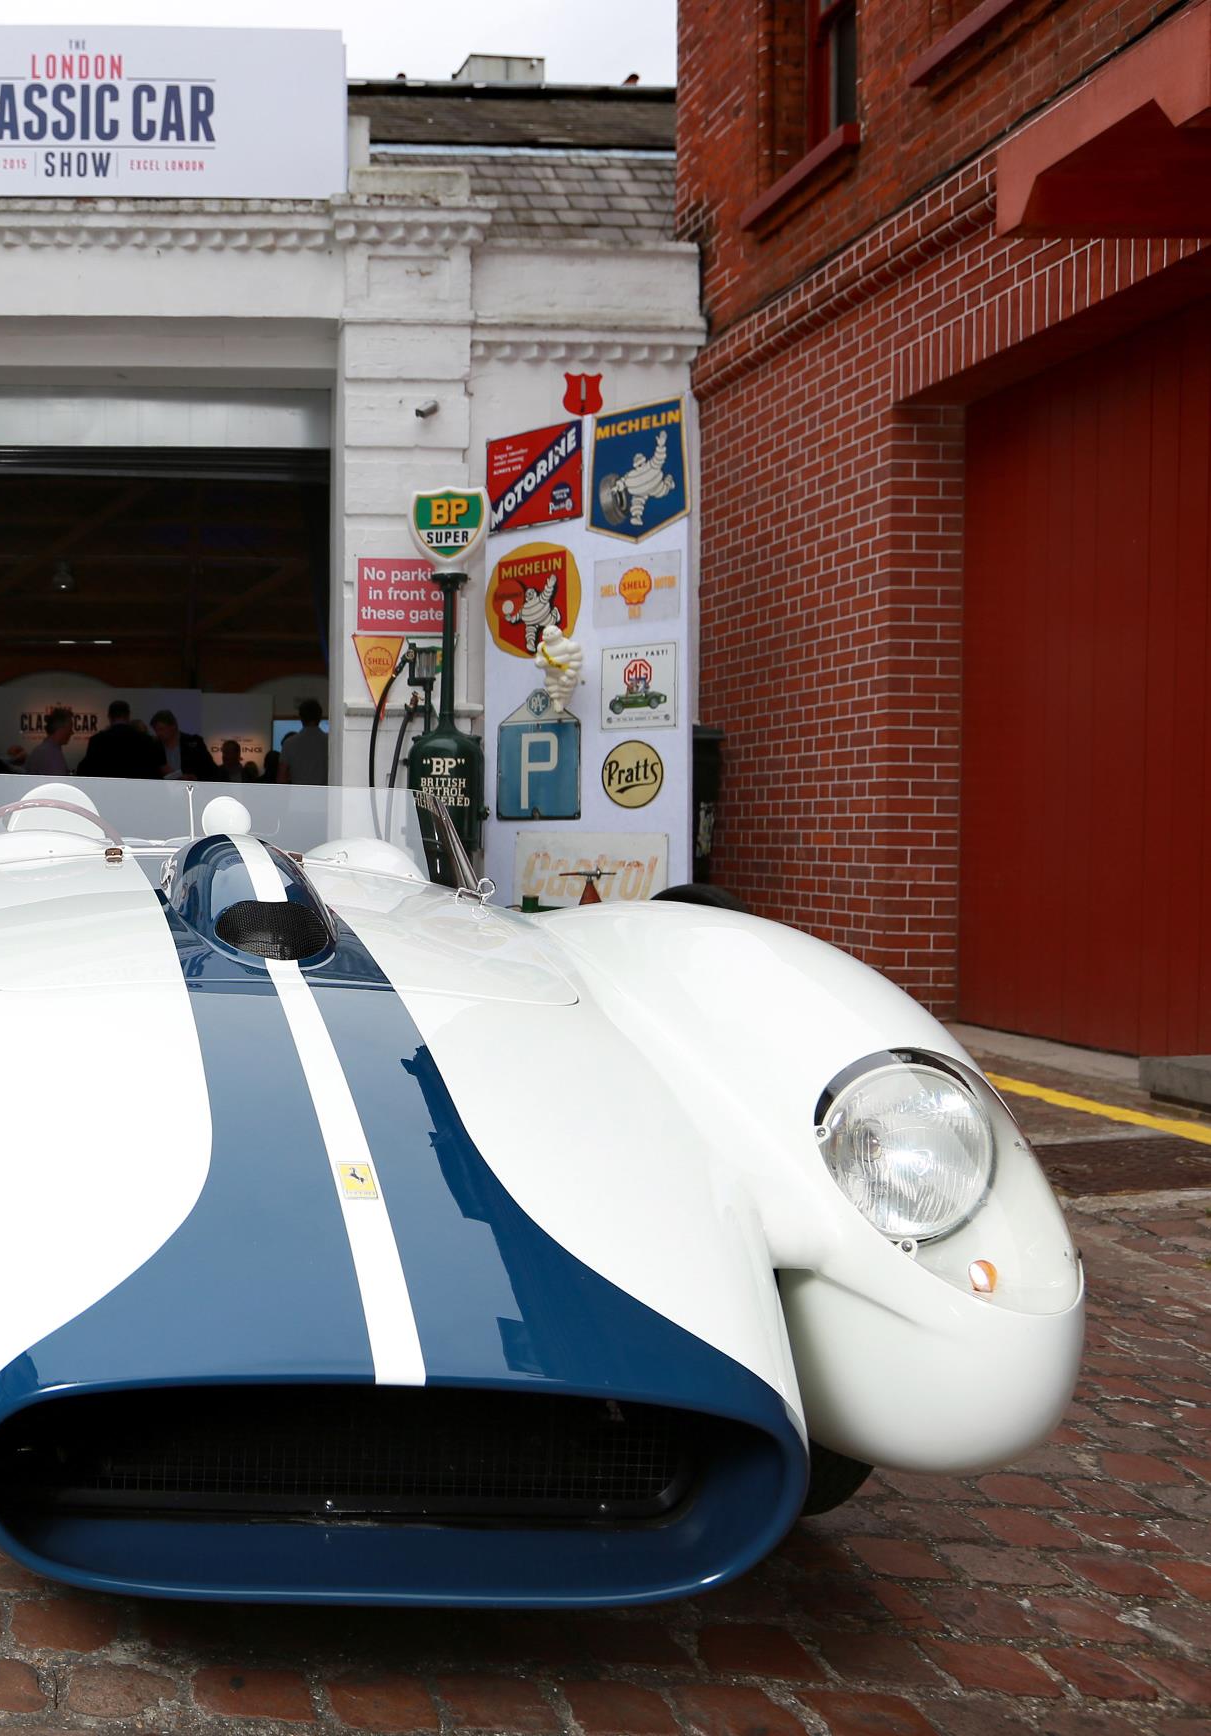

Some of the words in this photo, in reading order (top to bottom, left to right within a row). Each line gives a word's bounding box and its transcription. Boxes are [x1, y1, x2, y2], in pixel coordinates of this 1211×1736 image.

[68, 39, 86, 50] THE
[31, 54, 122, 80] LONDON
[132, 83, 216, 142] CAR
[2, 158, 27, 169] 2015
[44, 151, 111, 178] SHOW
[129, 159, 160, 171] EXCEL
[165, 160, 205, 172] LONDON
[596, 409, 681, 440] MICHELIN
[491, 427, 577, 530] MOTORINE
[430, 498, 469, 527] BP
[426, 530, 469, 545] SUPER
[363, 566, 386, 581] No
[390, 566, 433, 584] parki
[501, 558, 563, 580] MICHELIN
[368, 586, 383, 601] in
[387, 586, 426, 602] front
[600, 584, 618, 599] SHELL
[622, 579, 648, 592] SHELL
[361, 606, 405, 621] these
[409, 607, 444, 624] gate
[367, 656, 391, 667] SHELL
[74, 713, 98, 732] CAR
[520, 731, 559, 810] P
[605, 757, 660, 792] Pratts
[420, 777, 467, 789] BRITISH
[422, 786, 465, 798] PETROL
[521, 851, 659, 901] Castrol
